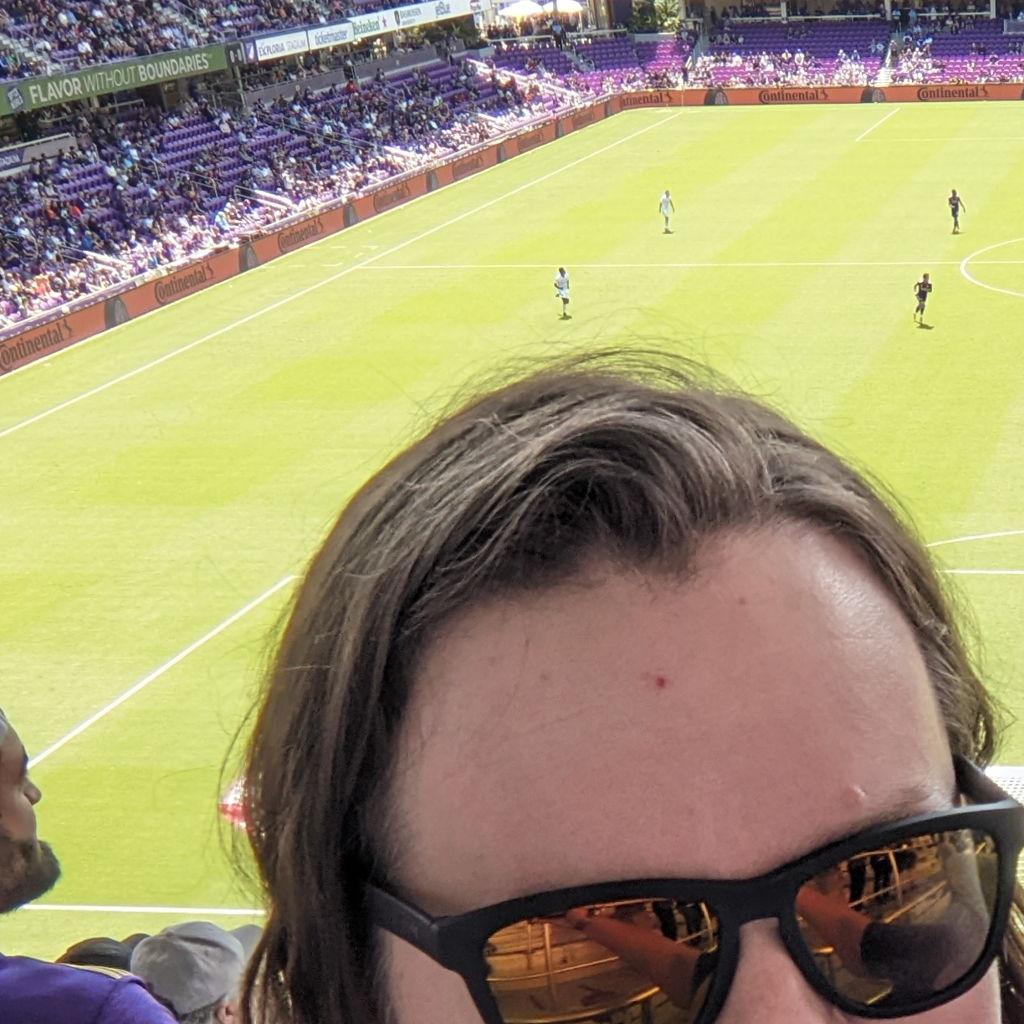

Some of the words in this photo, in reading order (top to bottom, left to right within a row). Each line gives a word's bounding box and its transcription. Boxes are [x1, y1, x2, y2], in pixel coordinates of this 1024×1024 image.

[29, 78, 82, 104] FLAVOR
[82, 66, 136, 93] WITHOUT
[138, 53, 209, 82] BOUNDARIES
[758, 89, 819, 104] Continental
[916, 85, 979, 101] Continental
[154, 269, 207, 306] Continental
